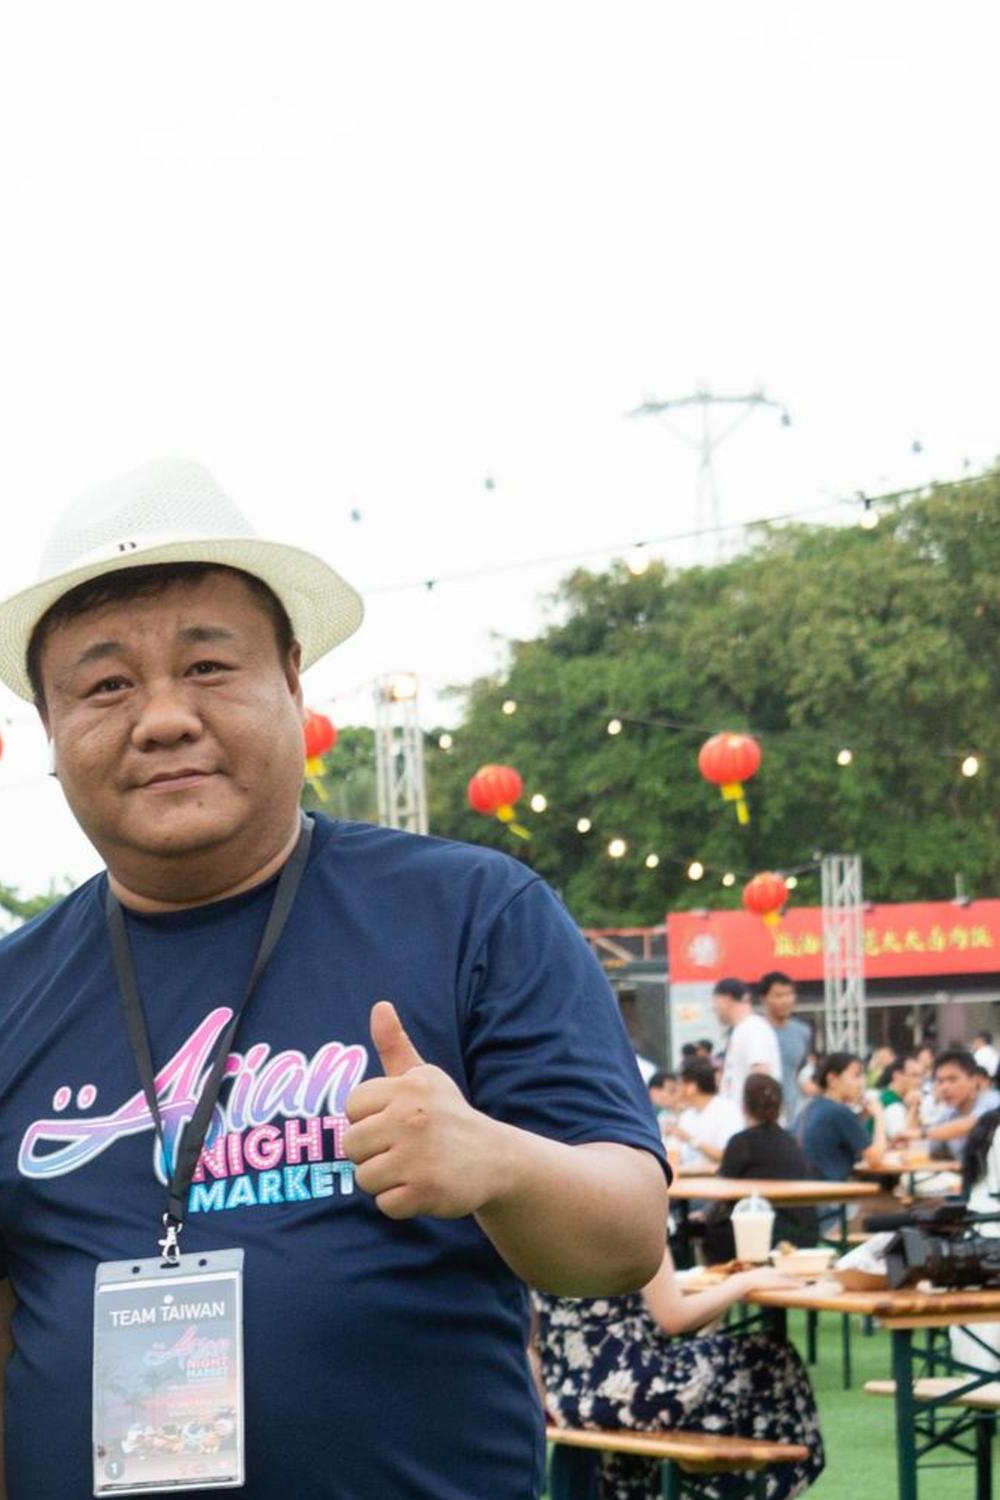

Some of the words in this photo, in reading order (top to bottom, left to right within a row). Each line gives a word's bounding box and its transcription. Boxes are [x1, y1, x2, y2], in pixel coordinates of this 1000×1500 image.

[191, 1116, 351, 1183] NIGHT
[187, 1160, 356, 1214] MARKET
[110, 1307, 156, 1328] TEAM
[161, 1301, 226, 1322] TAIWAN
